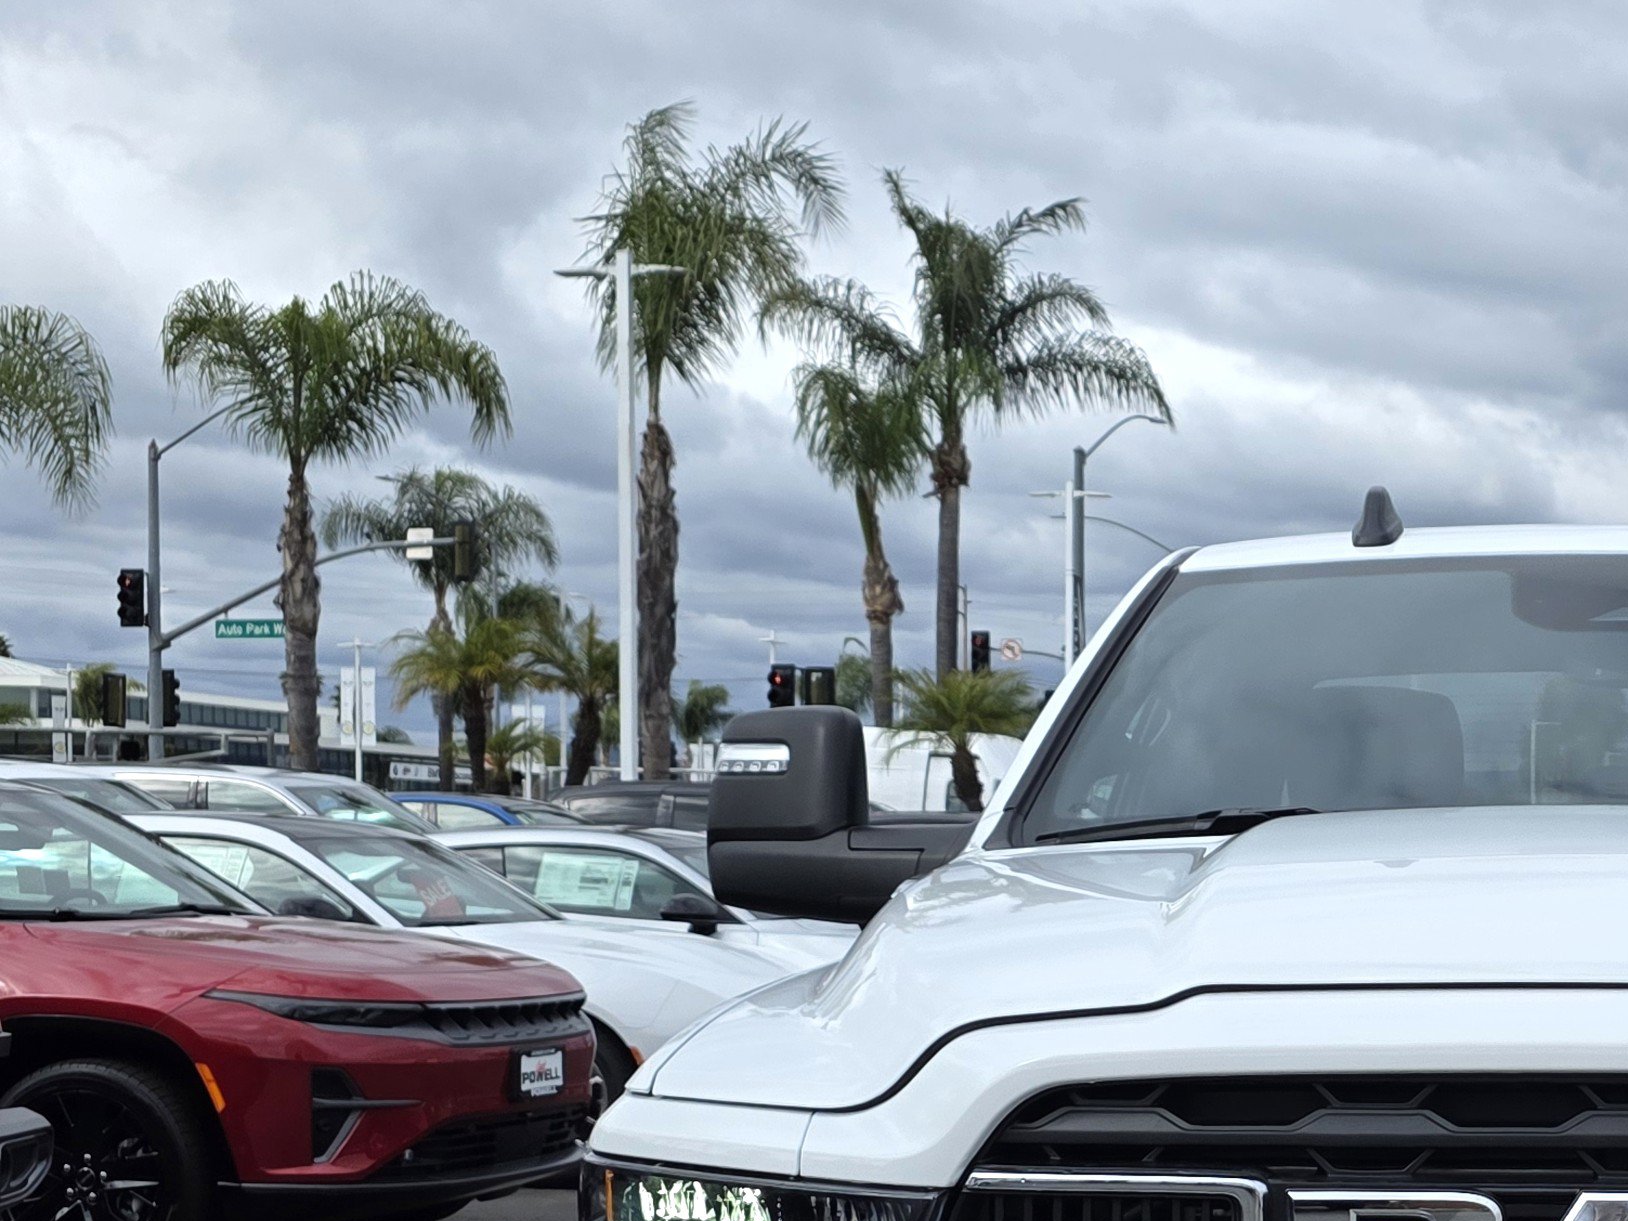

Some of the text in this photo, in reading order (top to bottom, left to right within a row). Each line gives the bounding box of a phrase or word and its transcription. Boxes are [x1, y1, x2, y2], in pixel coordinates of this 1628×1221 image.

[218, 623, 243, 635] Auto
[246, 622, 270, 635] Park
[522, 1067, 561, 1085] POWELL
